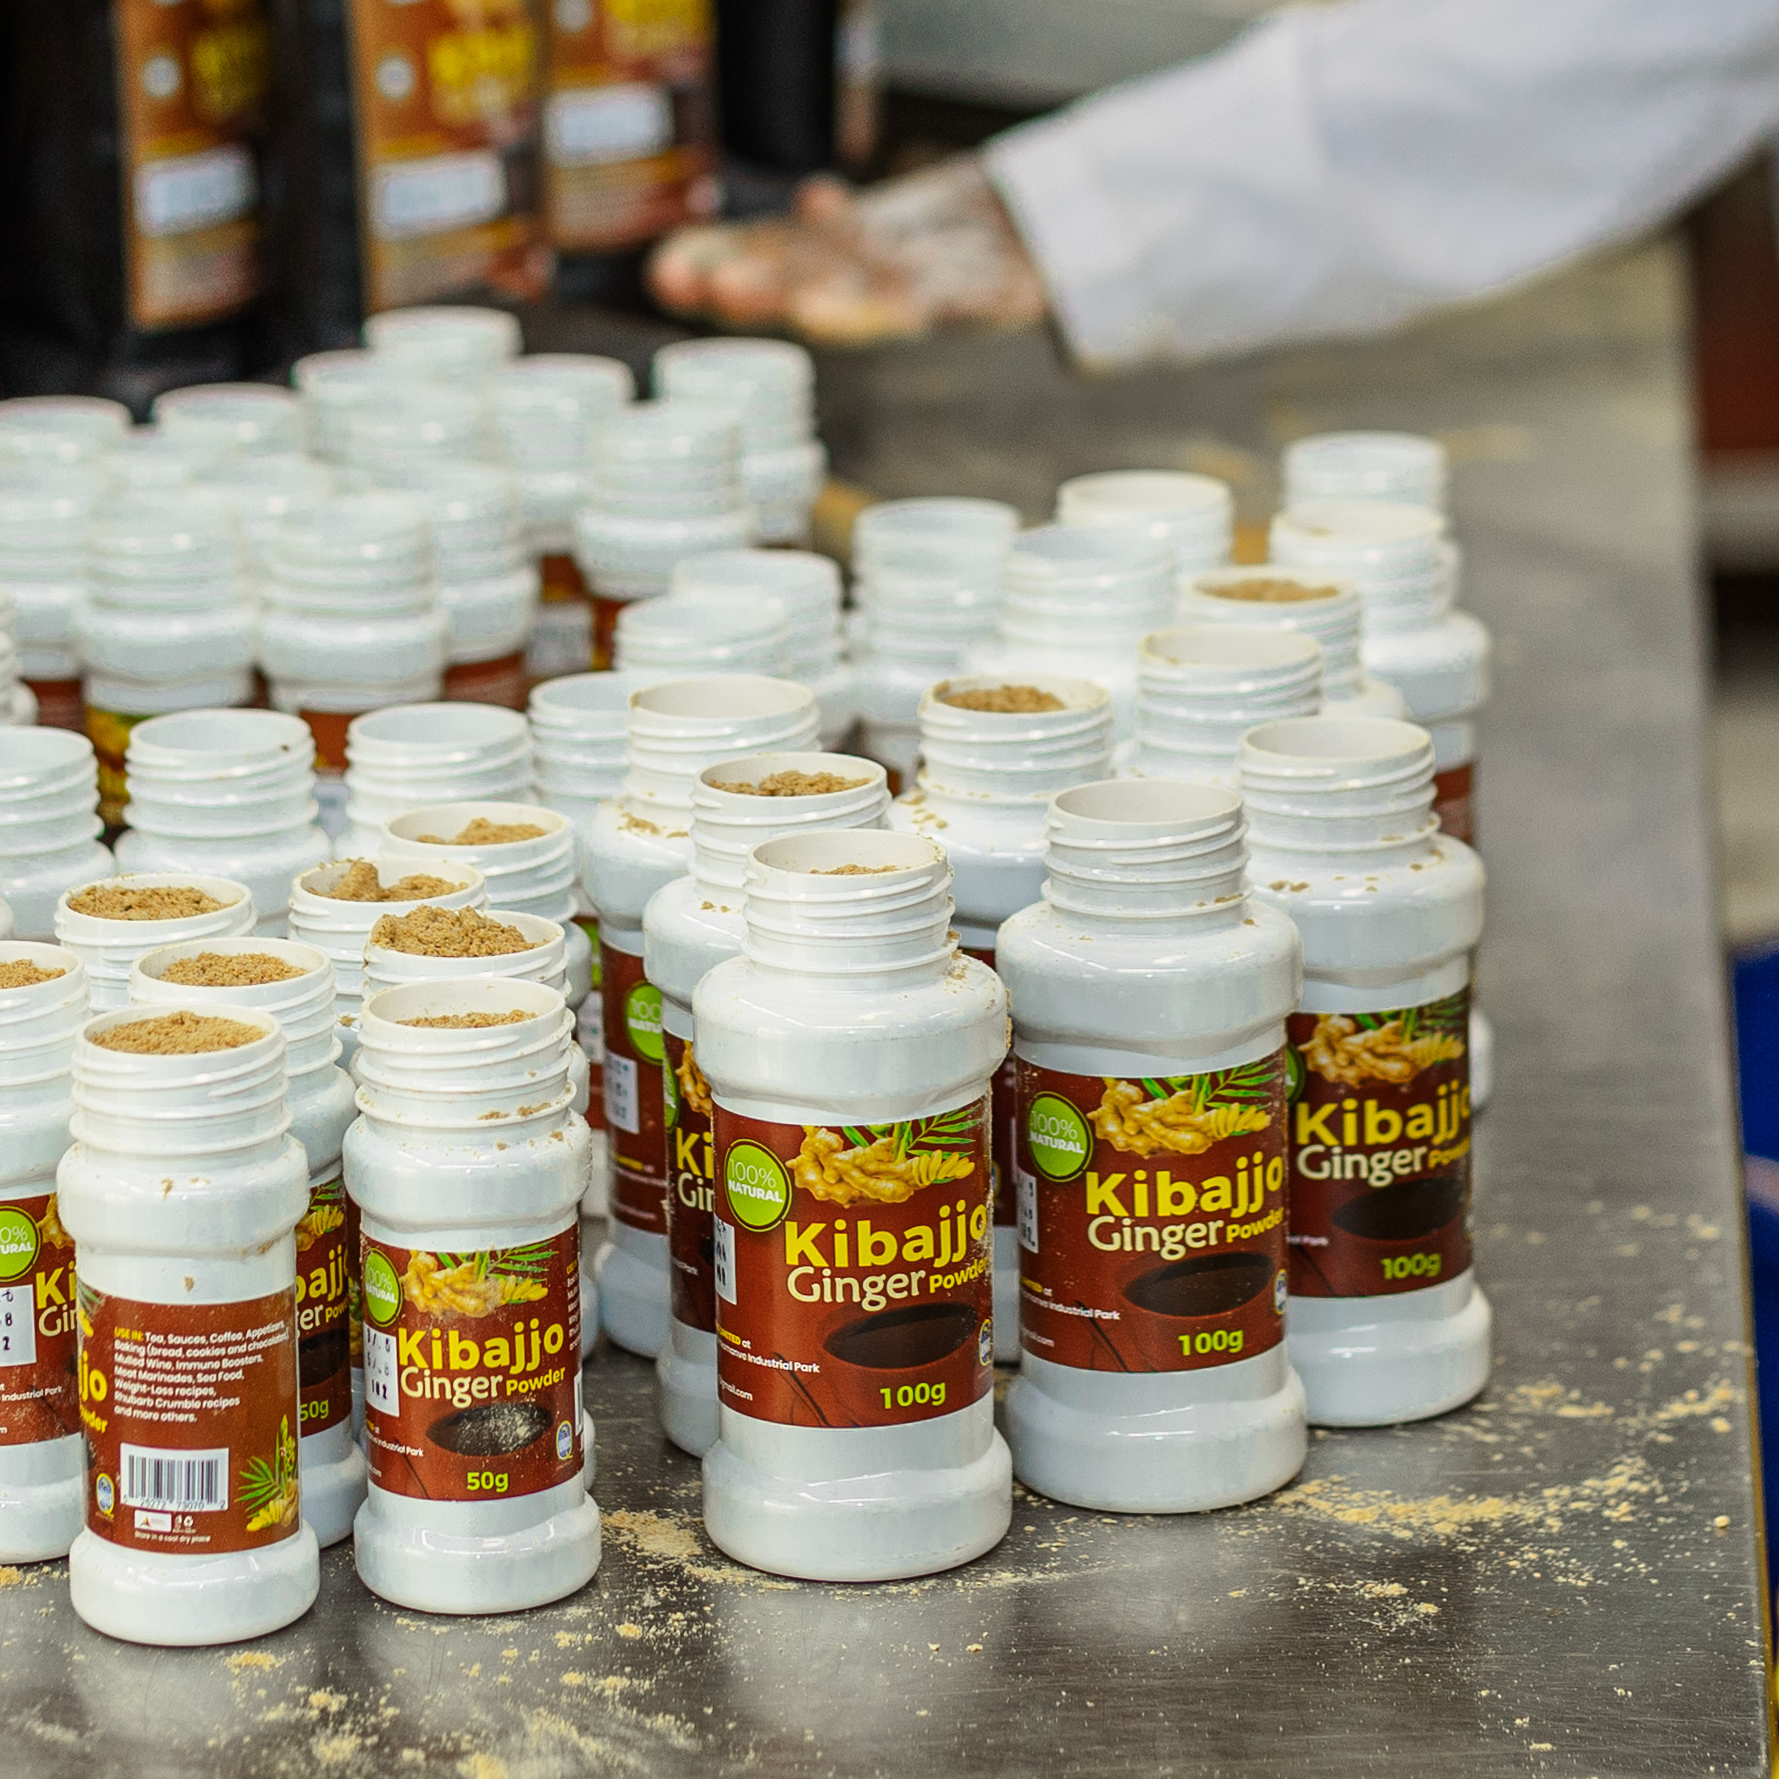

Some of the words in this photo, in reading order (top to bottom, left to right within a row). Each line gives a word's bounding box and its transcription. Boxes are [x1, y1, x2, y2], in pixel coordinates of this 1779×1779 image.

[1030, 1110, 1078, 1140] 100%
[1030, 1131, 1085, 1154] NATURAL
[730, 1158, 776, 1189] 100%
[1296, 1144, 1428, 1188] Ginger
[728, 1179, 784, 1204] NATURAL
[1086, 1150, 1284, 1218] Kibajjo
[785, 1200, 988, 1268] Kibajjo
[1087, 1214, 1224, 1261] Ginger
[1226, 1206, 1284, 1244] Powder
[1380, 1252, 1442, 1280] 100g
[786, 1266, 926, 1312] Ginger
[1094, 1309, 1120, 1321] Park
[114, 1327, 130, 1340] USE
[145, 1332, 167, 1345] Tea,
[168, 1334, 208, 1346] Sauces,
[398, 1318, 564, 1374] Kibajjo
[742, 1338, 752, 1350] at
[1178, 1329, 1244, 1356] 100g
[114, 1340, 146, 1357] Baking
[147, 1343, 184, 1358] (bread,
[186, 1346, 226, 1358] cookies
[228, 1342, 246, 1355] and
[114, 1352, 144, 1367] Mulled
[146, 1357, 174, 1370] Wine,
[176, 1360, 221, 1370] Immune
[748, 1352, 793, 1371] Industrial
[794, 1362, 820, 1374] Park
[114, 1366, 138, 1378] Meat
[138, 1370, 196, 1384] Marinades,
[196, 1372, 217, 1383] Sea
[2, 1389, 44, 1402] Industrial
[44, 1386, 63, 1396] Park
[114, 1378, 174, 1396] Weight-Loss
[175, 1386, 216, 1398] recipes,
[400, 1366, 504, 1408] Ginger
[506, 1367, 566, 1396] Powder
[880, 1382, 946, 1410] 100g
[114, 1390, 154, 1407] Rhubarb
[156, 1397, 201, 1410] Crumble
[202, 1396, 240, 1410] recipes
[300, 1400, 329, 1422] 50g
[114, 1404, 133, 1418] and
[133, 1408, 160, 1420] more
[160, 1412, 198, 1422] others.
[406, 1446, 424, 1458] Park
[466, 1472, 509, 1493] 50g
